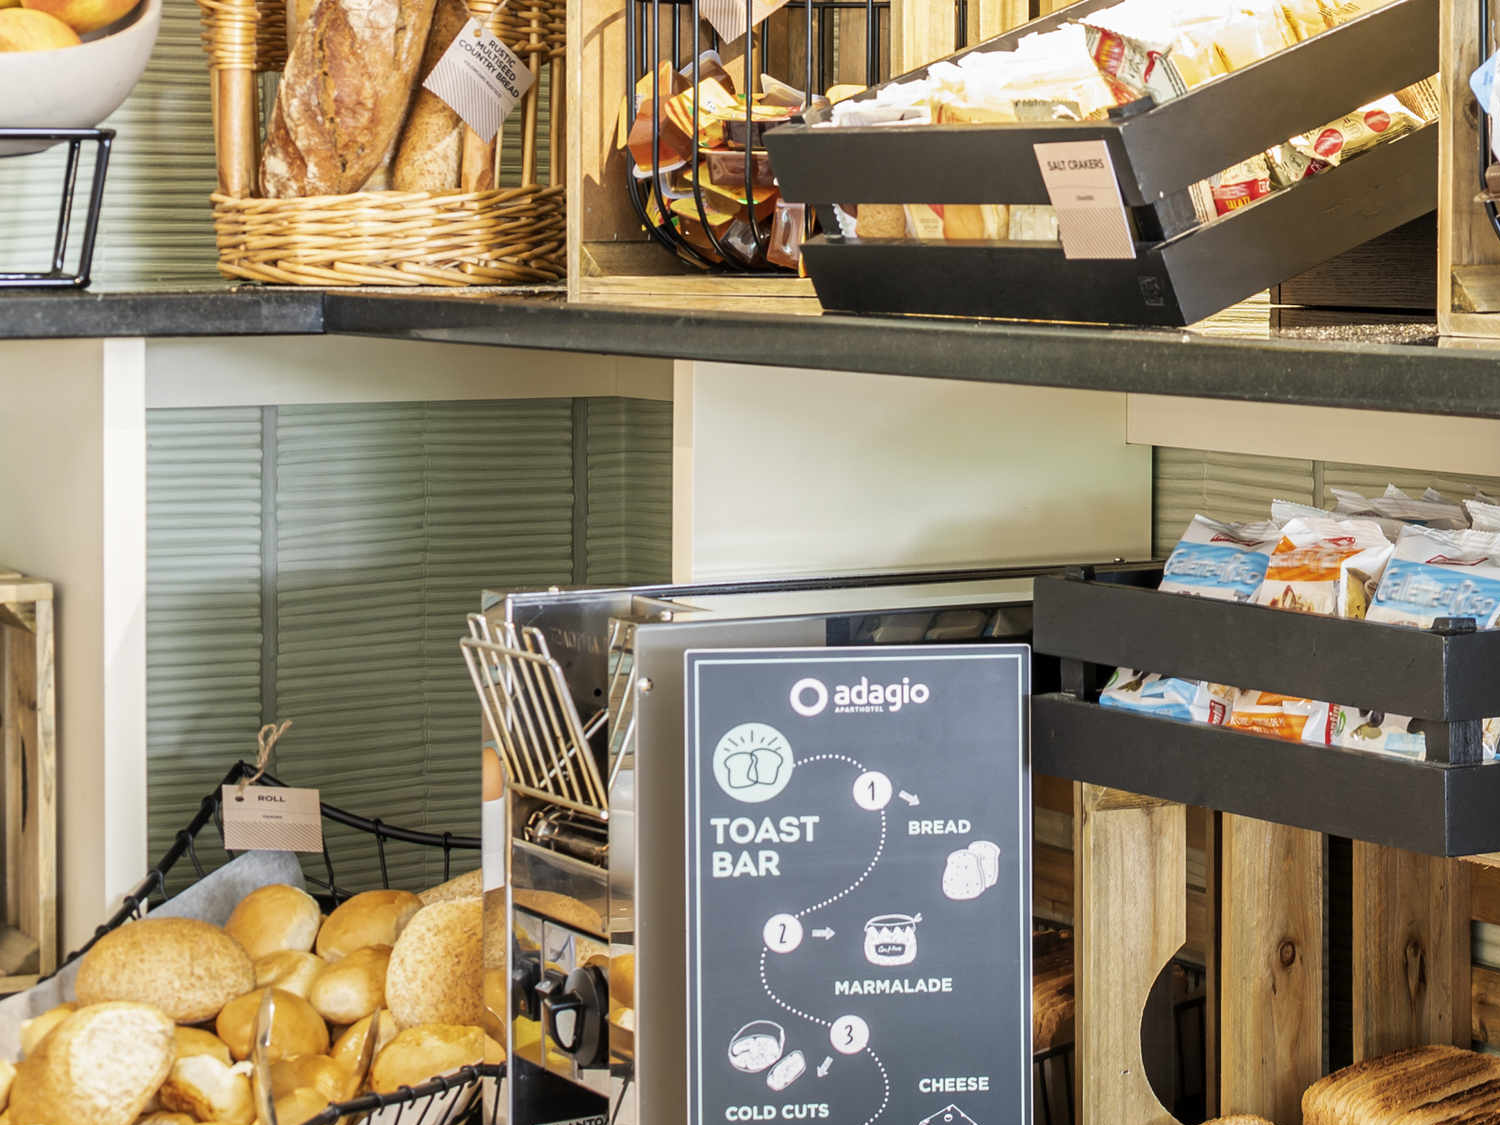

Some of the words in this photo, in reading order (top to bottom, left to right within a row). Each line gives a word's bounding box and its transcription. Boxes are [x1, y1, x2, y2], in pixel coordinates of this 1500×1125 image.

[474, 41, 517, 81] MULTISEED
[488, 40, 516, 69] RUSTIC
[458, 39, 498, 74] COUNTRY
[495, 71, 520, 98] BREAD
[1047, 160, 1066, 171] SALT
[1067, 157, 1105, 170] CRAKERS
[833, 676, 930, 713] adagio
[257, 794, 286, 803] ROLL
[867, 780, 876, 801] 1
[710, 815, 820, 845] TOAST
[908, 819, 972, 836] BREAD
[711, 849, 781, 878] BAR
[778, 923, 787, 944] 2
[834, 977, 953, 996] MARMALADE
[844, 1024, 853, 1046] 3
[918, 1076, 990, 1093] CHEESE
[725, 1105, 777, 1121] COLD
[781, 1103, 830, 1120] CUTS
